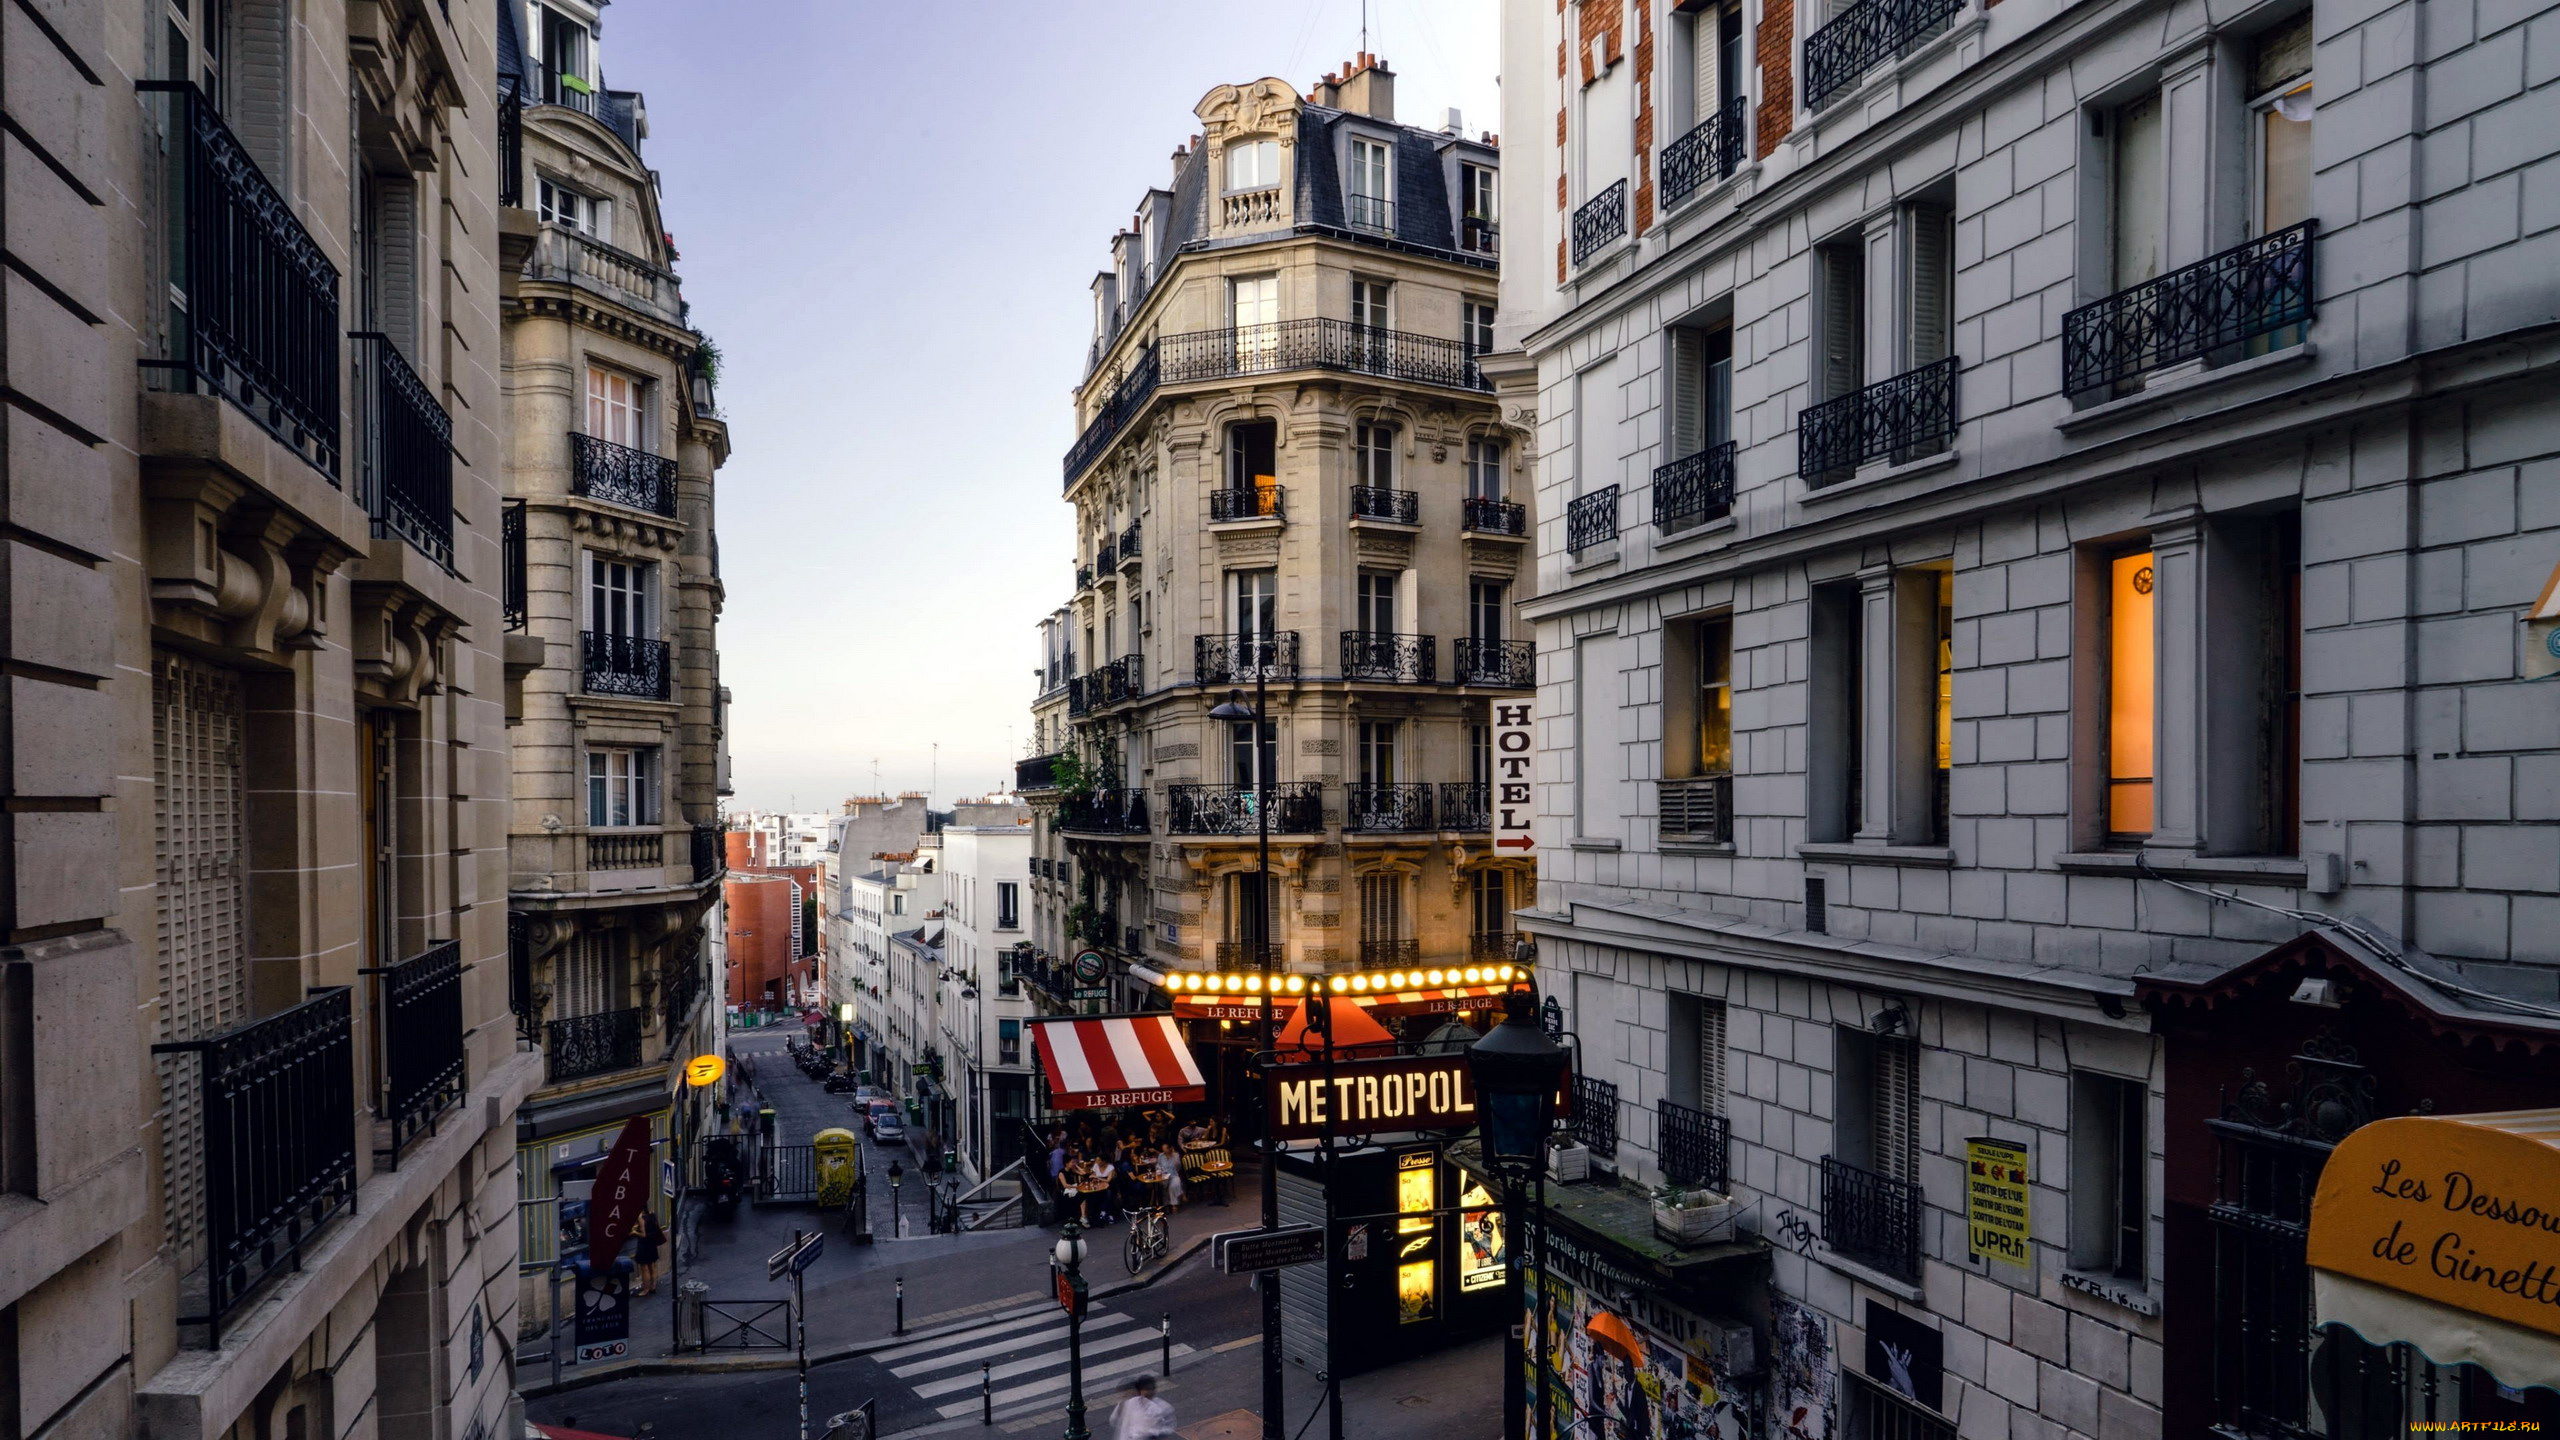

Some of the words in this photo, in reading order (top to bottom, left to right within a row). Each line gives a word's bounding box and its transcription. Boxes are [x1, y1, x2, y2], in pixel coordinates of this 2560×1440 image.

[1497, 705, 1532, 830] HOTEL
[1083, 989, 1108, 998] REFUGE
[1208, 1007, 1225, 1019] LE
[1228, 1007, 1284, 1020] REFUE
[1430, 1002, 1444, 1013] LE
[1447, 997, 1493, 1011] REFUGE
[1086, 1095, 1107, 1107] LE
[1111, 1090, 1173, 1105] REFUGE
[1402, 1156, 1431, 1167] Presse
[2372, 1159, 2431, 1202] Les
[605, 1148, 638, 1238] TABAC
[1973, 1181, 1997, 1195] SORTIR
[1998, 1187, 2007, 1197] DE
[2008, 1189, 2023, 1203] L'UE
[1973, 1196, 1993, 1209] SORTIR
[1994, 1202, 2002, 1211] DE
[2003, 1205, 2024, 1217] L'EURO
[1973, 1210, 1994, 1223] SORTIR
[1995, 1216, 2003, 1225] DE
[2003, 1218, 2024, 1231] L'OTAN
[1262, 1238, 1299, 1249] Montmartre
[1265, 1245, 1303, 1256] Montmartre
[1544, 1226, 1577, 1260] lorales
[1579, 1250, 1589, 1267] et
[1974, 1227, 2025, 1258] UPR.fr
[2372, 1220, 2418, 1265] de
[580, 1342, 626, 1360] LOTO
